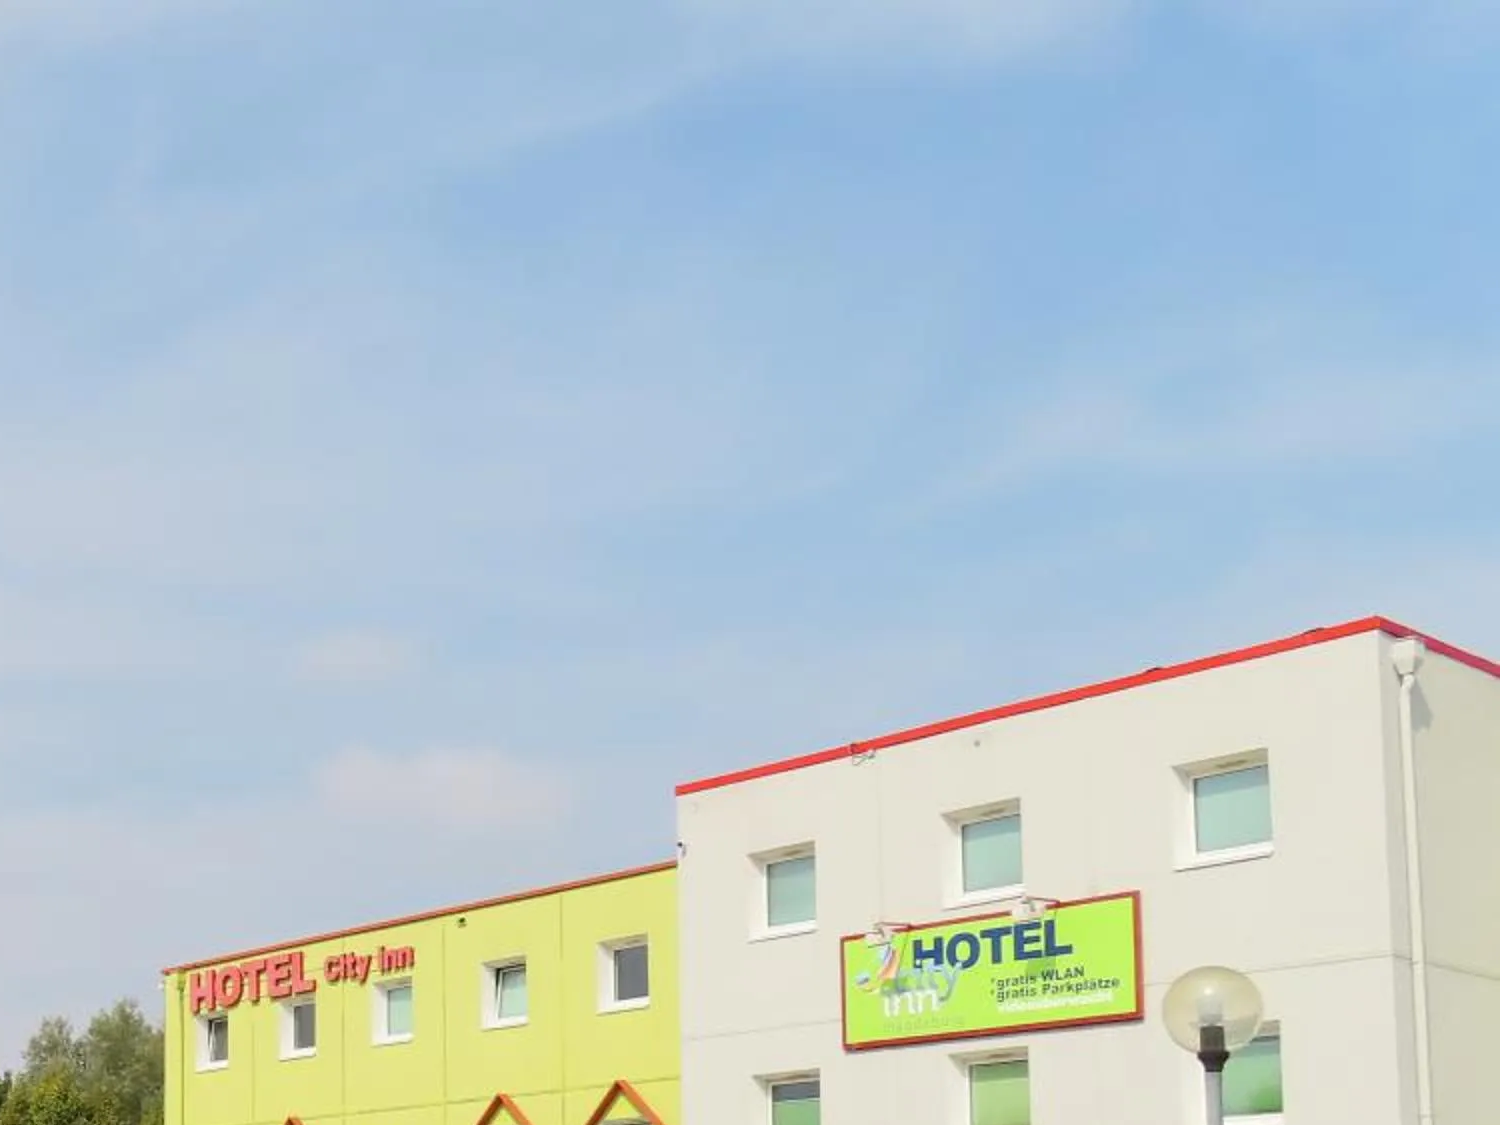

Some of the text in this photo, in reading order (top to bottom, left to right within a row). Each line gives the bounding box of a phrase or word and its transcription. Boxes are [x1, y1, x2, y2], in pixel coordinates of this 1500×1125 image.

[912, 919, 1074, 969] HOTEL
[189, 951, 317, 1015] HOTEL
[996, 966, 1085, 992] gratis WLAN
[996, 986, 1038, 1003] gratis
